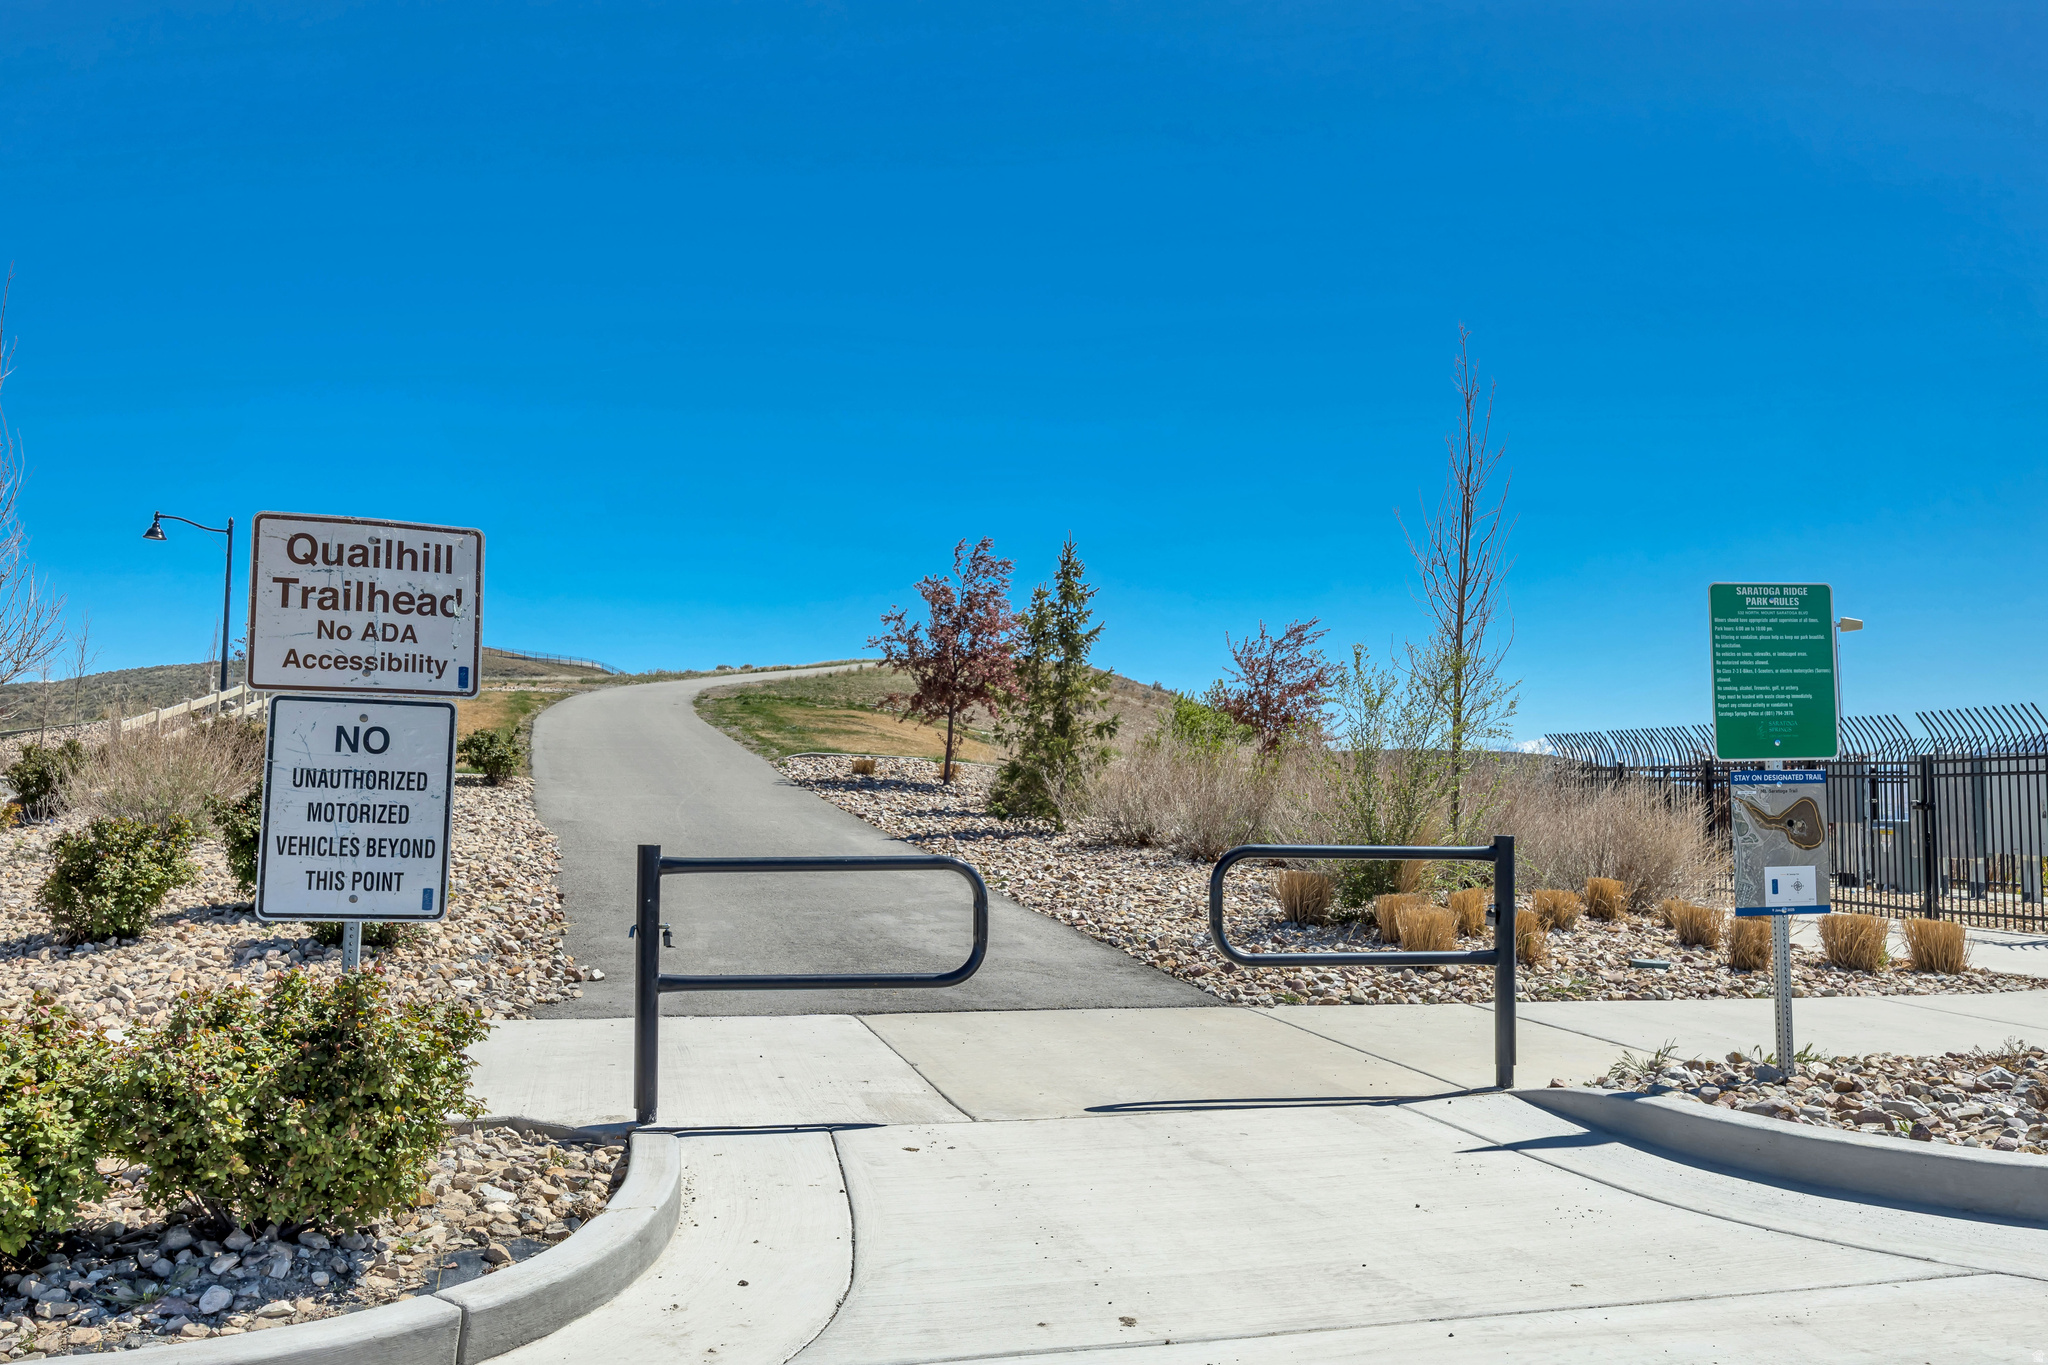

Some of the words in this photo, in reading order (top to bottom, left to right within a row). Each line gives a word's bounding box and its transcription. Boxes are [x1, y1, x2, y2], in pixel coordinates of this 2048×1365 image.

[286, 533, 452, 574] Quailhill
[272, 577, 462, 617] Trailhead
[1736, 587, 1780, 595] SARATOGA
[1783, 587, 1808, 595] RIDGE
[1746, 597, 1768, 605] PARK
[1774, 597, 1799, 605] RULES
[317, 620, 352, 640] No
[361, 622, 418, 644] ADA
[282, 649, 448, 679] Accessibility
[335, 726, 390, 754] NO
[293, 768, 428, 791] UNAUTHORIZED
[307, 802, 409, 824] MOTORIZED
[276, 836, 360, 857] VEHICLES
[366, 838, 436, 858] BEYOND
[306, 871, 345, 891] THIS
[351, 872, 404, 892] POINT
